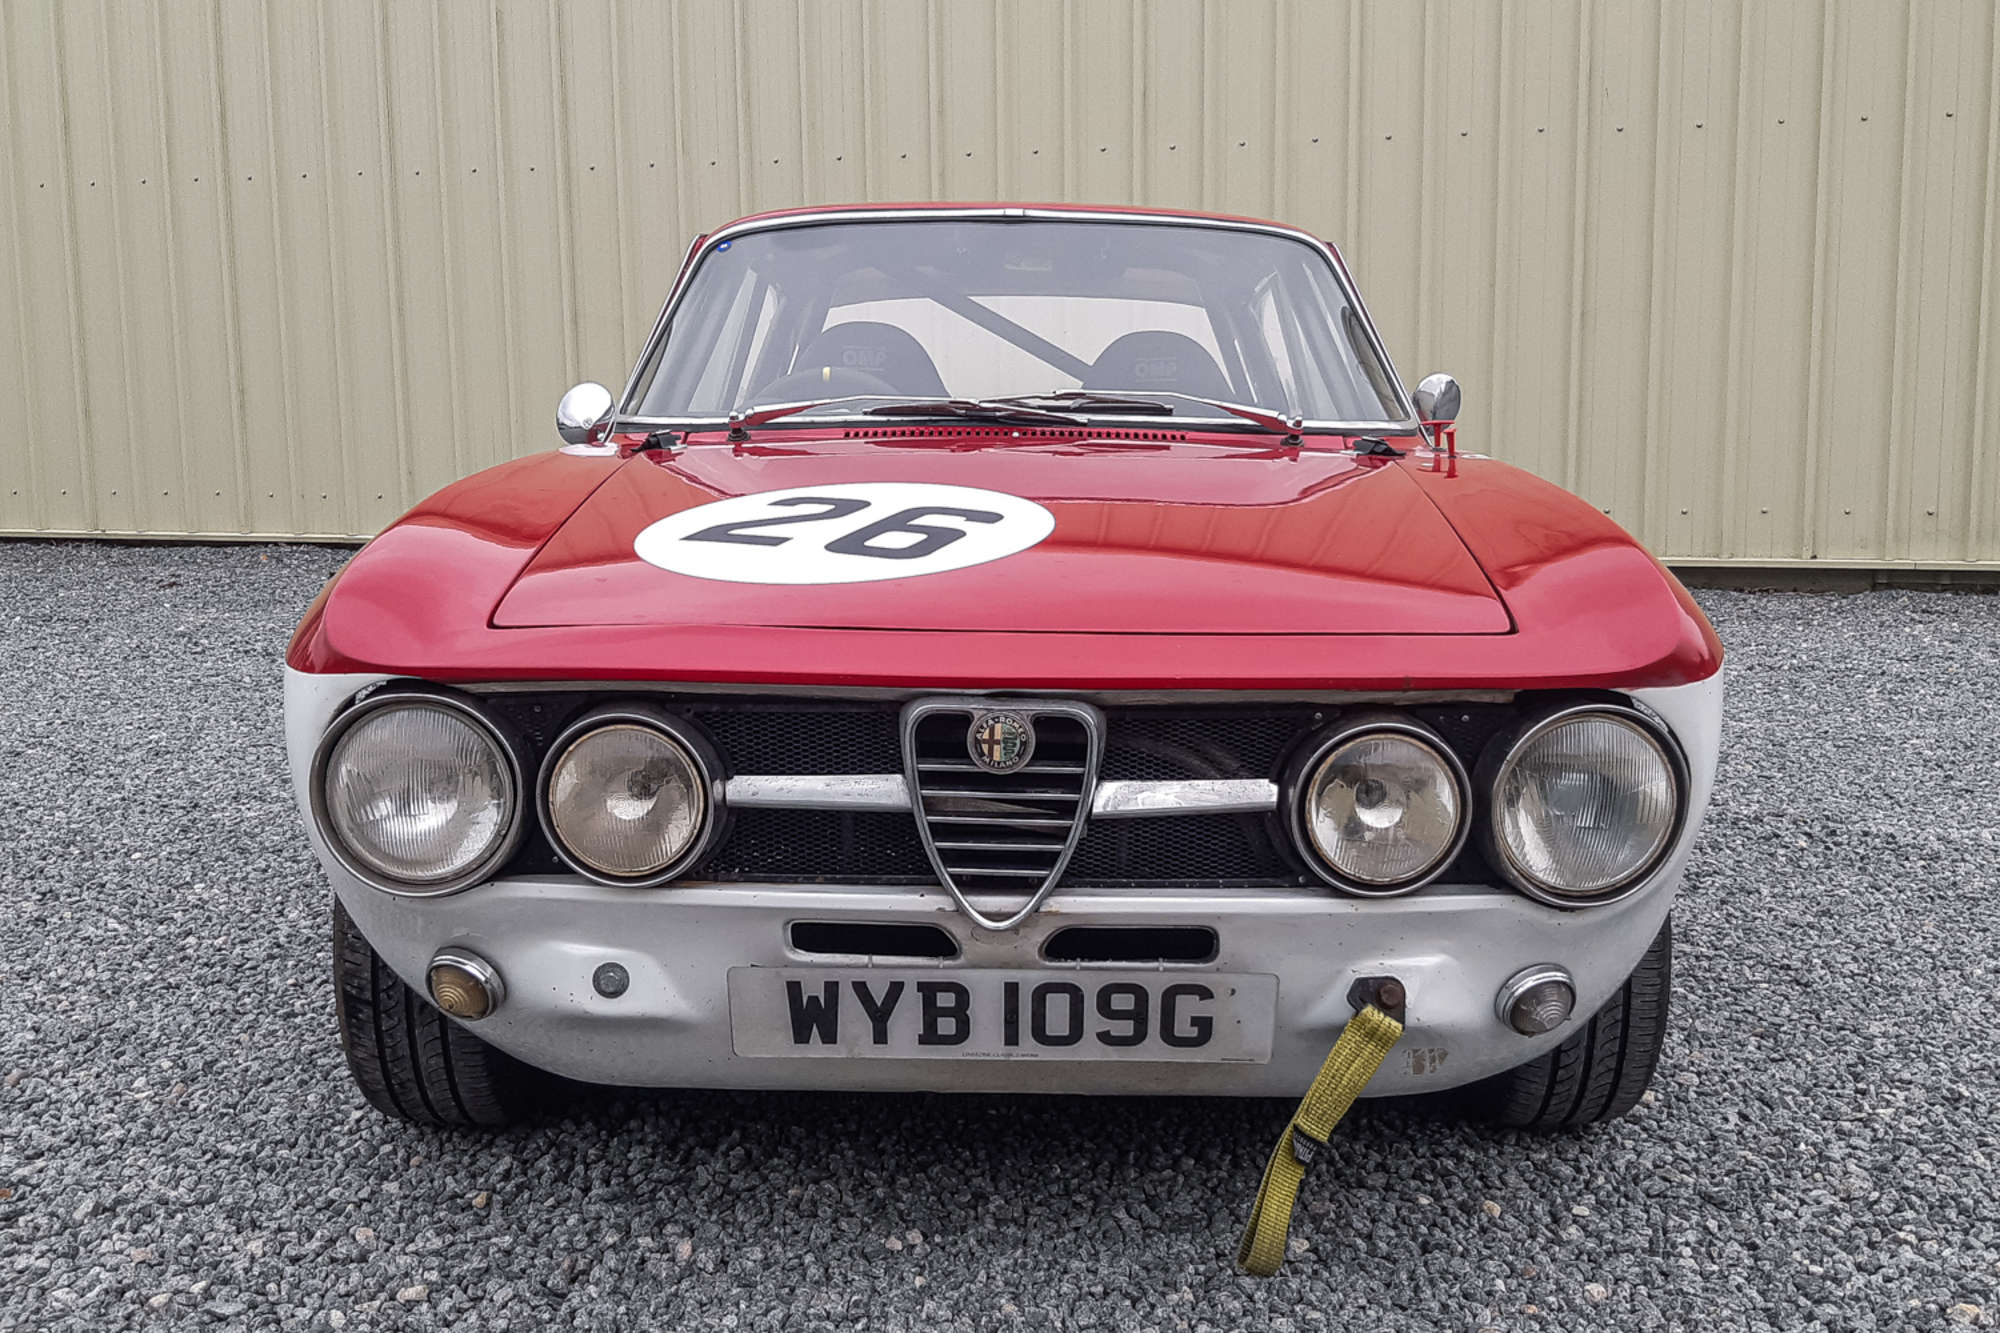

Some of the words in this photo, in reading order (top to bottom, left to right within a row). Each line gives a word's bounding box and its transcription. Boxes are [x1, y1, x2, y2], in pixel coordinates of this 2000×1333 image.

[679, 496, 1004, 560] 26
[981, 755, 1019, 767] MILANO
[785, 980, 971, 1046] WYB
[1003, 981, 1215, 1048] 109G
